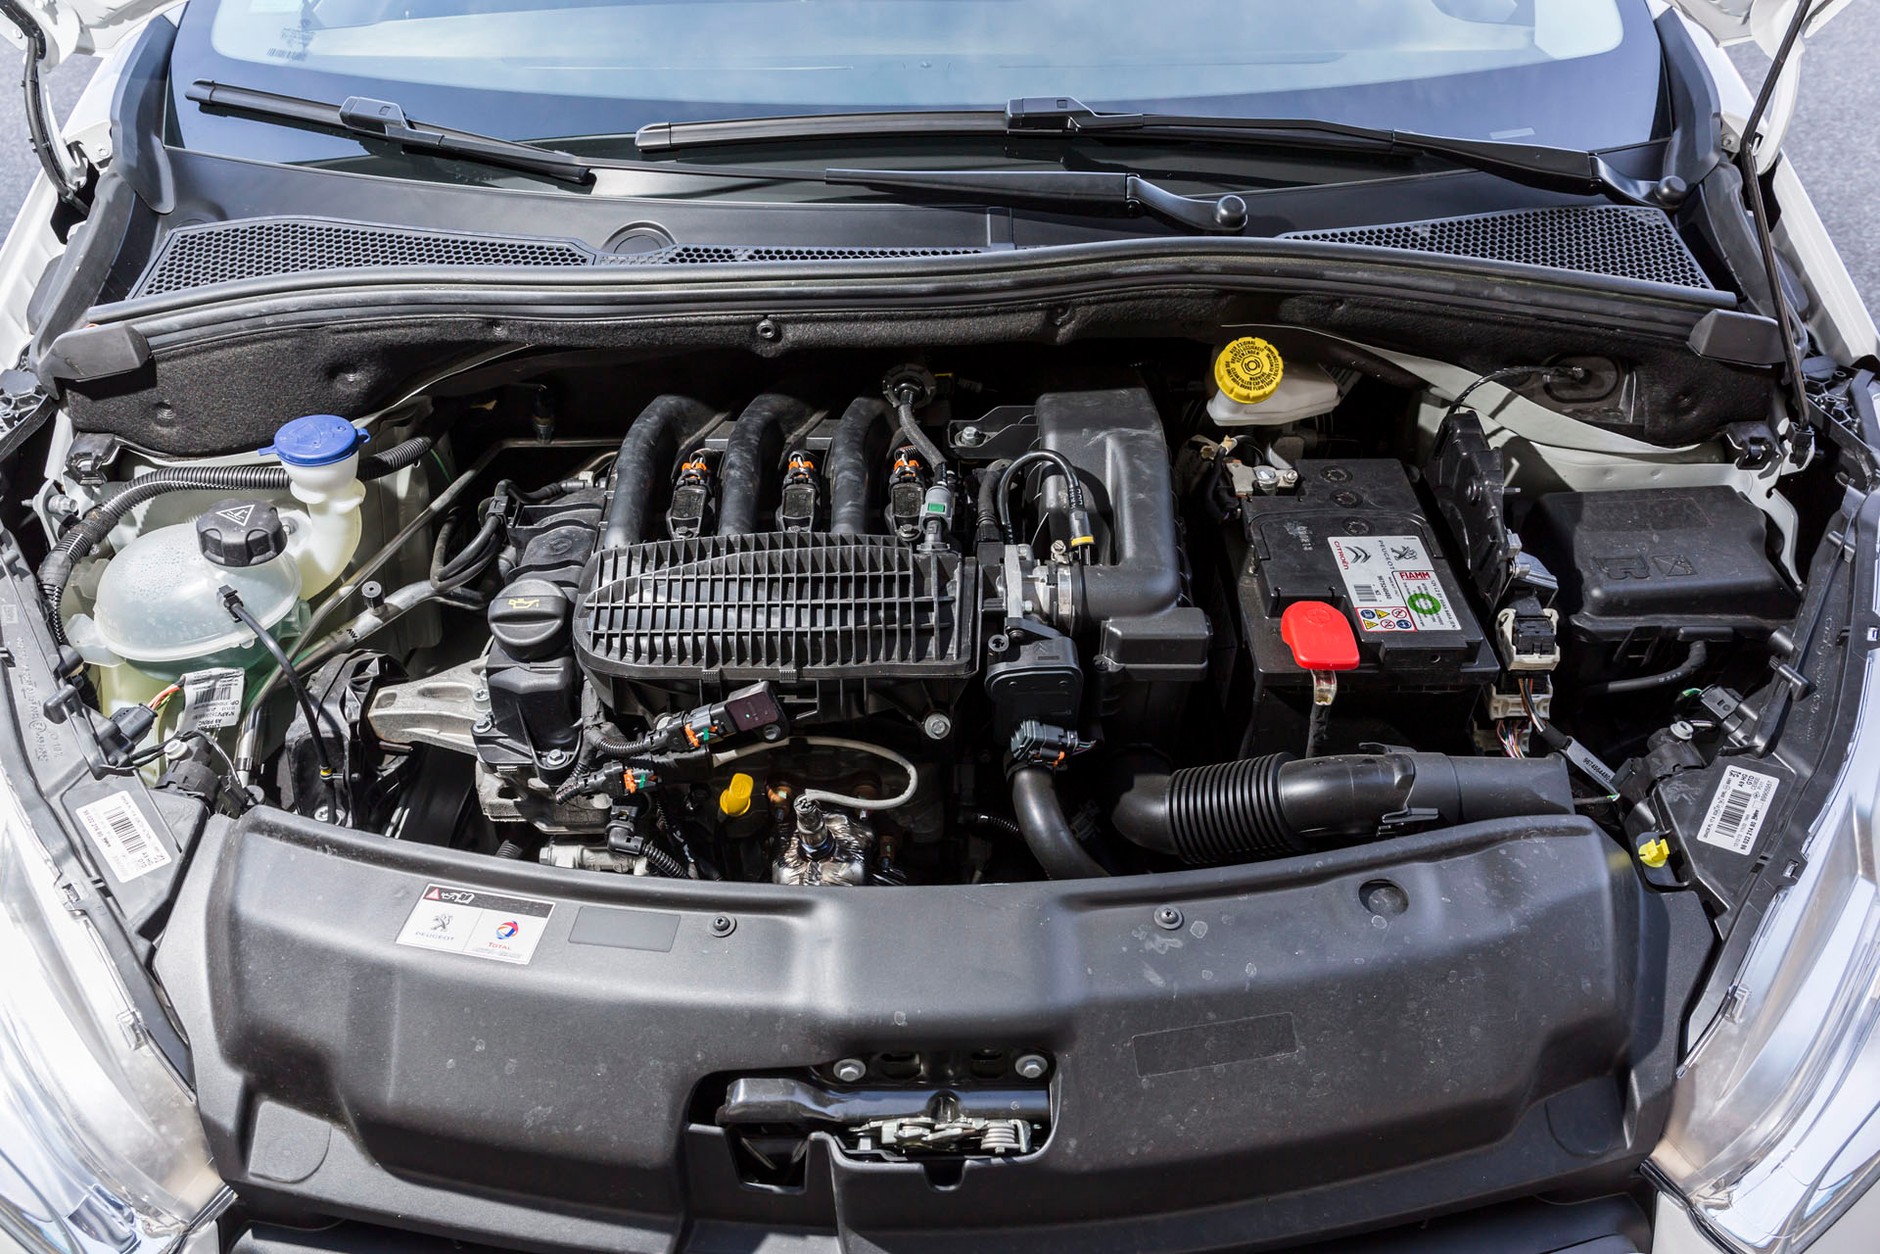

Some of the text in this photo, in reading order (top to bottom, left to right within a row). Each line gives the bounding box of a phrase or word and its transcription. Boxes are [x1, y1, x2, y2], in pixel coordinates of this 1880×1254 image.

[1378, 540, 1395, 570] PEUGEOT
[416, 931, 454, 941] PEUGEOT
[488, 942, 512, 950] TOTAL
